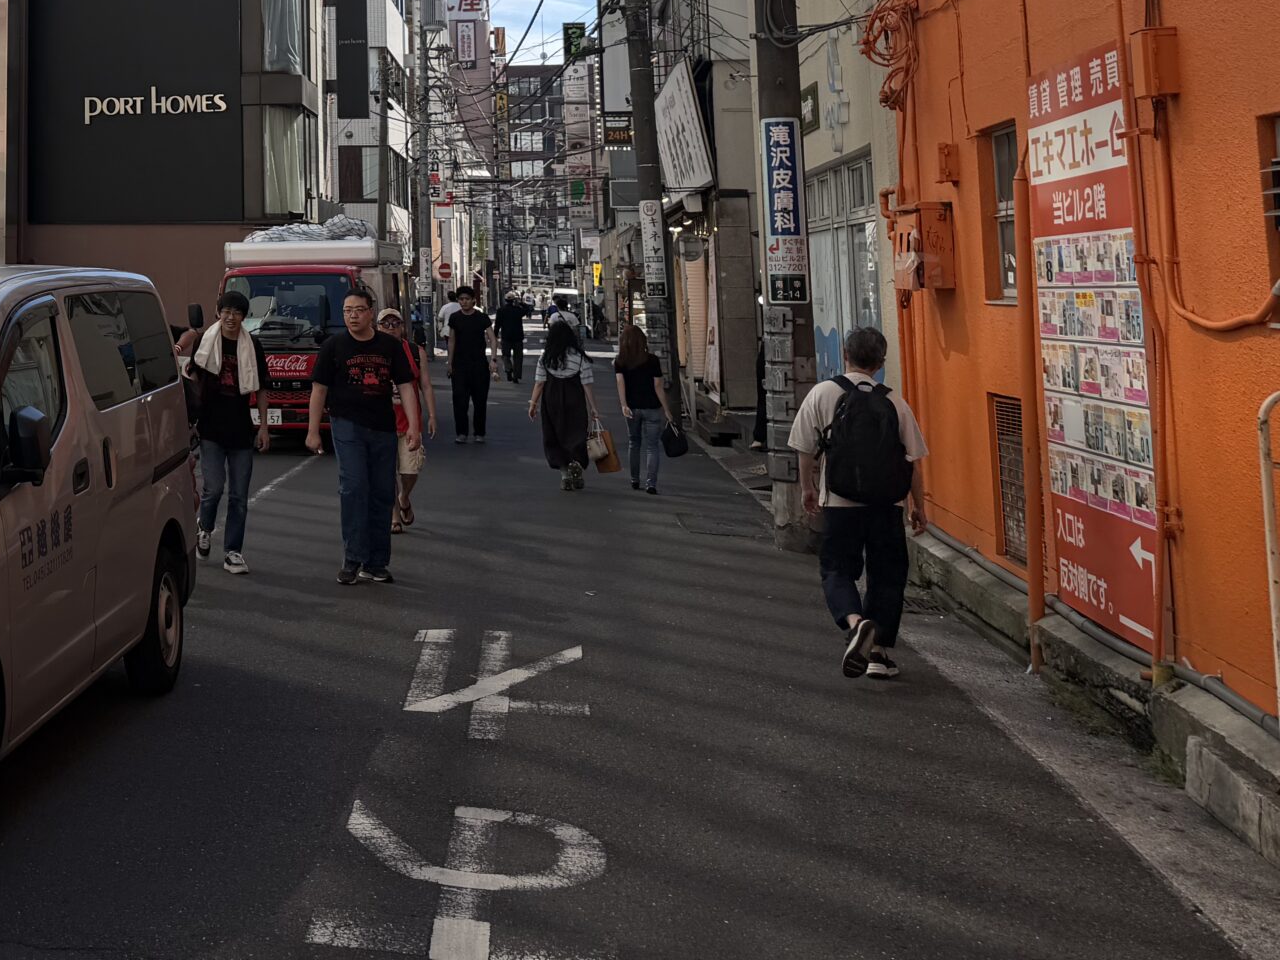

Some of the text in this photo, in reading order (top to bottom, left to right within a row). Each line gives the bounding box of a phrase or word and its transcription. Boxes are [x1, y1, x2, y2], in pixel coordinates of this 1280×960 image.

[1057, 66, 1083, 109] 管理
[1089, 51, 1120, 96] 売買
[608, 131, 628, 140] 24H
[769, 125, 795, 233] 滝沢皮膚科
[1053, 183, 1107, 225] 当ビル2階
[1057, 509, 1085, 548] 入口は
[1060, 557, 1113, 615] 反対側です。
